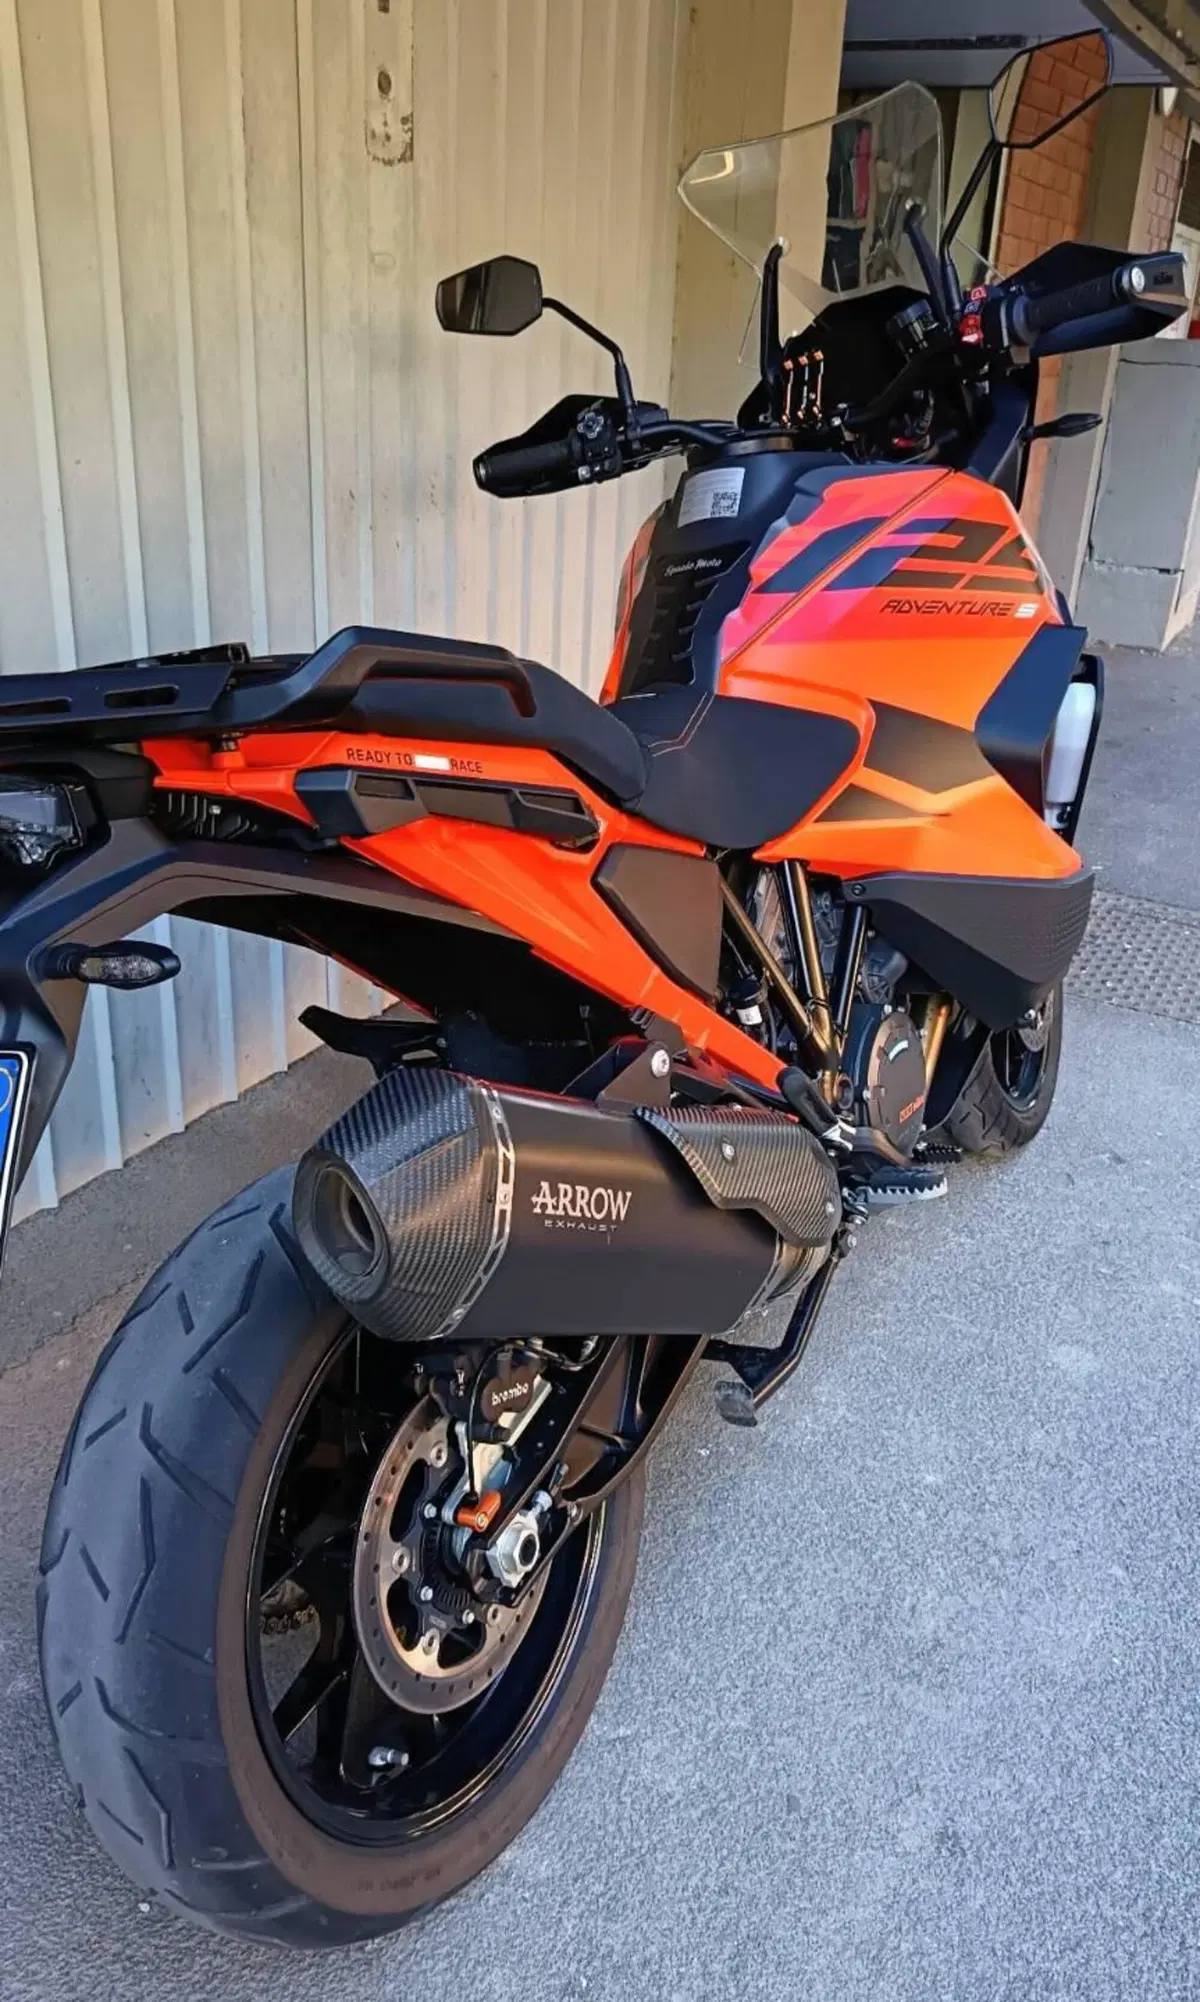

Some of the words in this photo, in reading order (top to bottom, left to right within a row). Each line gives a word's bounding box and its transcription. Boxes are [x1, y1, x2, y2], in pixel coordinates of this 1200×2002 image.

[879, 600, 1014, 616] ADVENTURE
[346, 747, 392, 764] READY
[395, 751, 414, 766] TO
[450, 758, 483, 774] RACE
[531, 1181, 632, 1221] ARROW
[544, 1220, 618, 1232] EXHAUST
[491, 1382, 529, 1406] brembo
